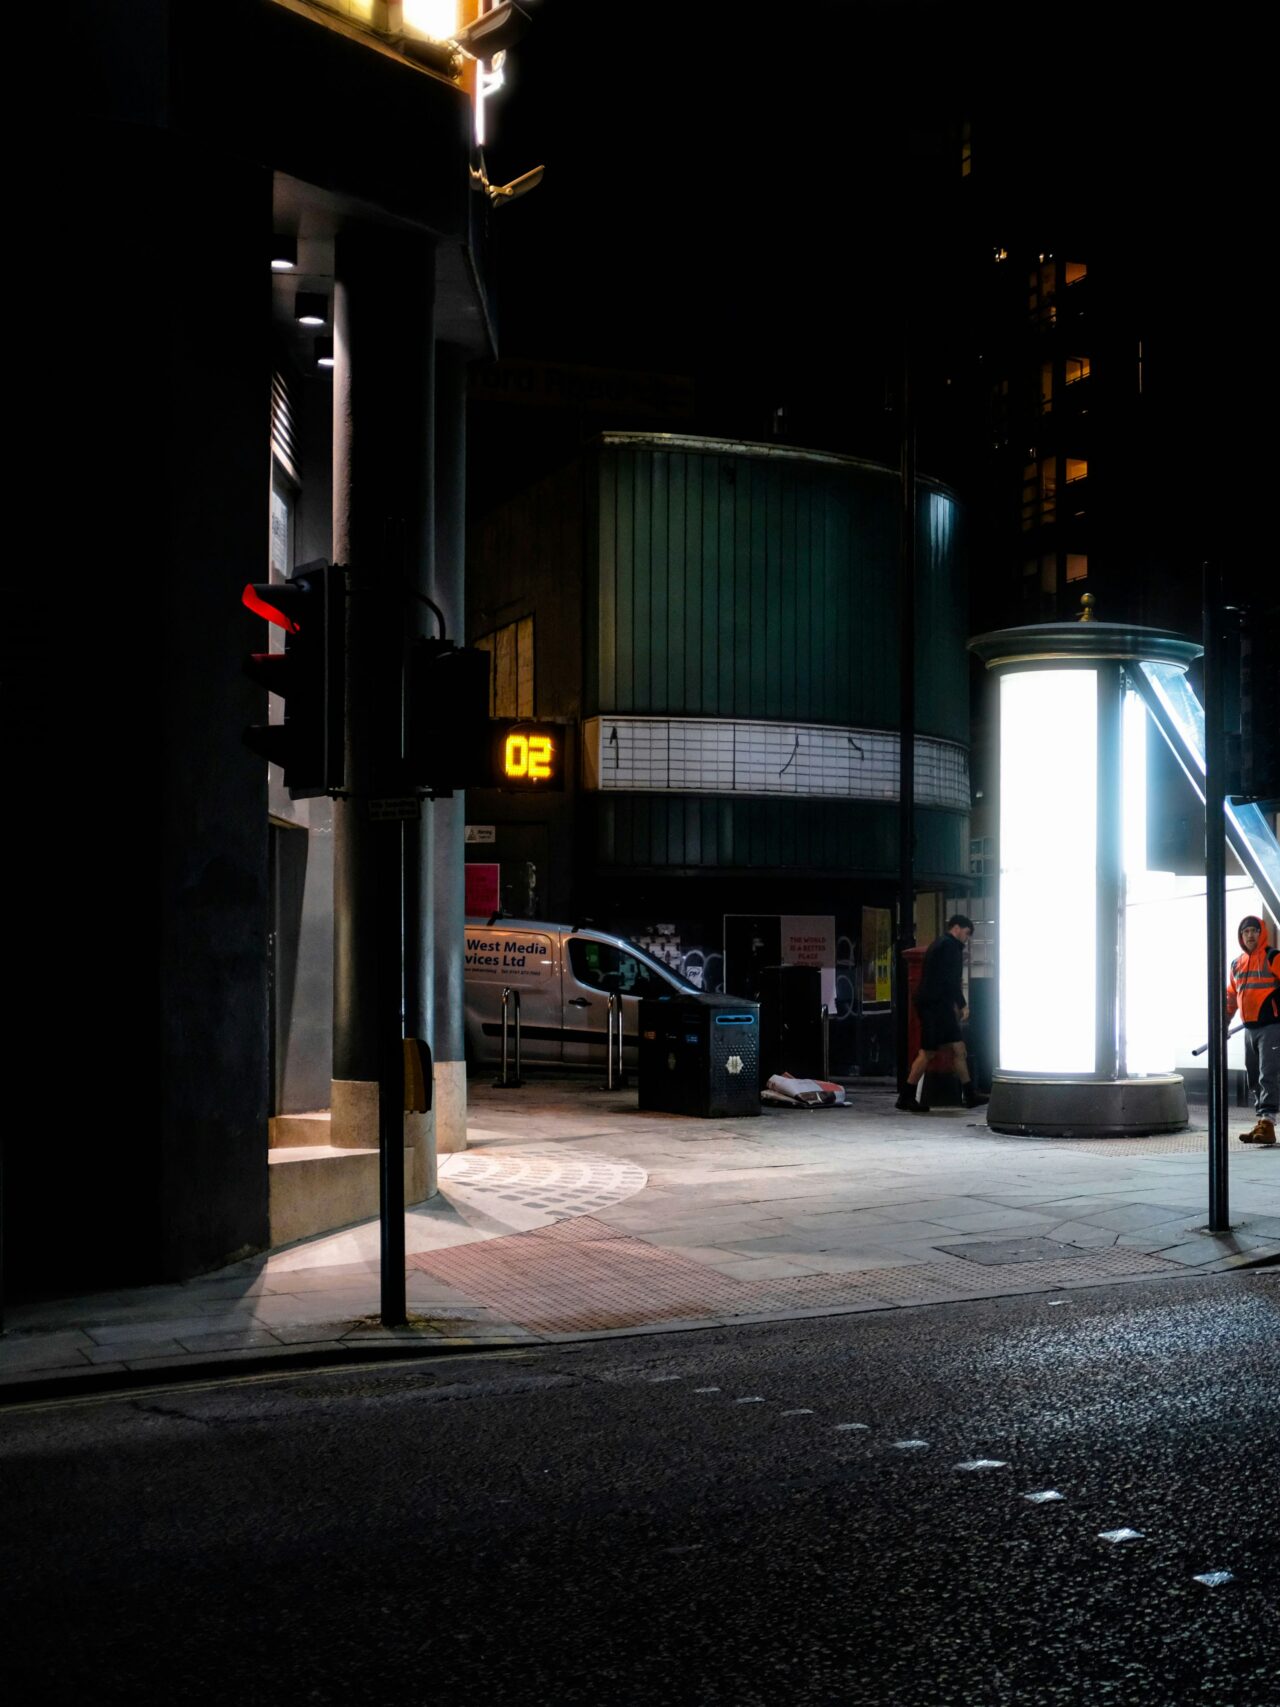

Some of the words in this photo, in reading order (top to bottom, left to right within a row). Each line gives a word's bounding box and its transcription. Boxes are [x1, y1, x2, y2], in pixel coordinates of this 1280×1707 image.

[505, 734, 552, 778] 02
[466, 939, 501, 952] West
[503, 941, 547, 955] Media
[465, 953, 499, 966] vices
[502, 955, 526, 967] Ltd
